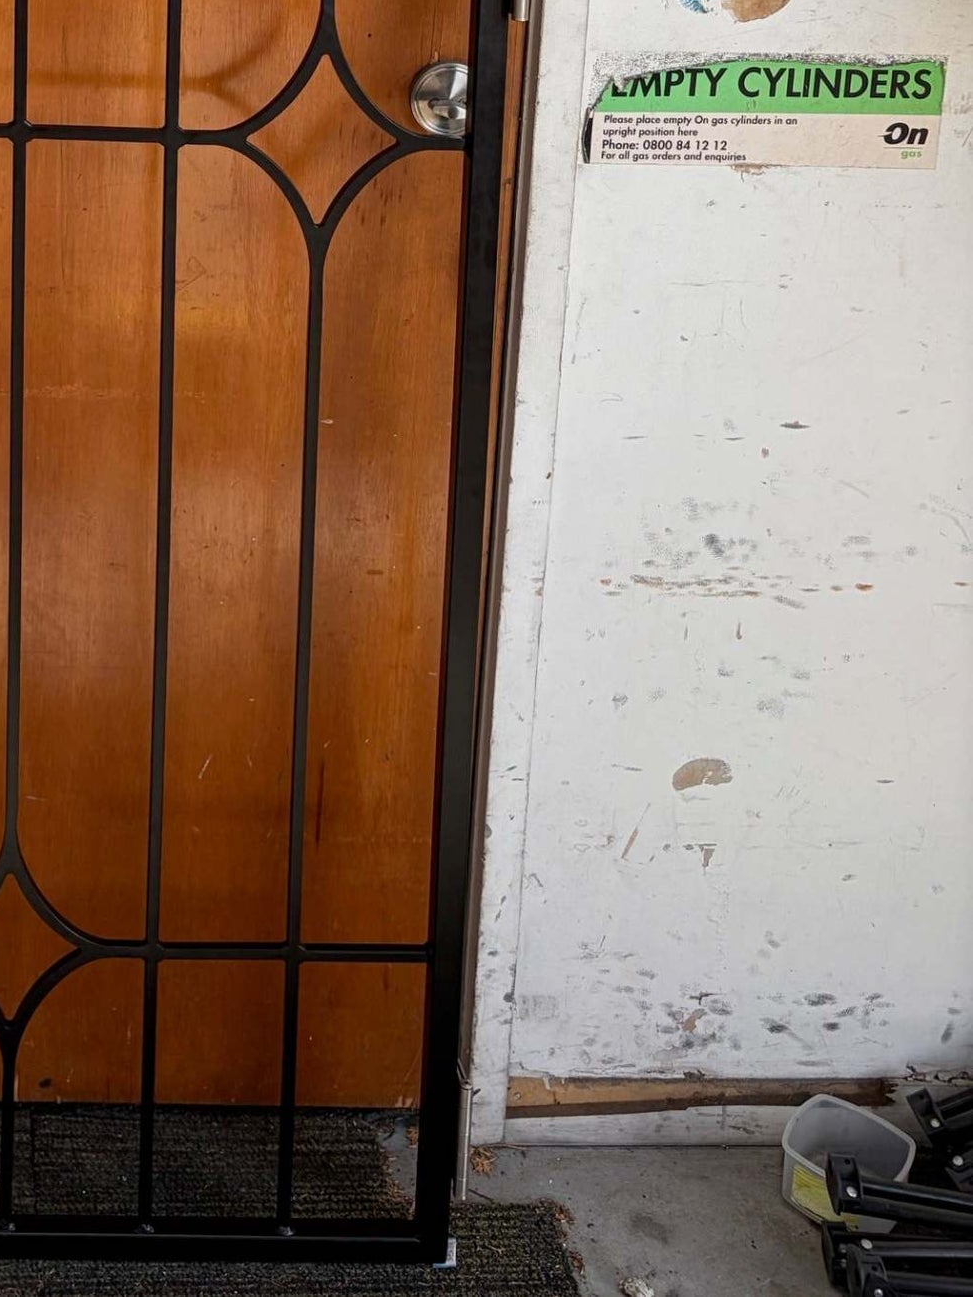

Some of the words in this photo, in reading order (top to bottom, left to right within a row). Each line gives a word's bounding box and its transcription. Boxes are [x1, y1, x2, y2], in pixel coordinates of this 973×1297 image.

[737, 66, 932, 100] CYLINDERS
[603, 114, 634, 124] Please
[635, 114, 661, 126] place
[663, 115, 691, 126] empty
[694, 115, 709, 125] On
[711, 117, 728, 126] gas
[730, 115, 771, 127] cylinders
[774, 115, 783, 125] in
[785, 117, 798, 125] an
[602, 127, 636, 138] upright
[638, 127, 675, 138] position
[677, 127, 699, 137] here
[879, 122, 929, 145] On
[602, 139, 639, 150] Phone:
[643, 140, 672, 150] 0800
[676, 140, 690, 151] 84
[696, 140, 709, 151] 12
[714, 140, 727, 151] 12
[601, 151, 616, 160] For
[618, 151, 630, 160] all
[632, 152, 650, 162] gas
[652, 151, 681, 161] orders
[683, 152, 702, 161] and
[704, 152, 747, 163] enquiries
[900, 148, 922, 159] gas
